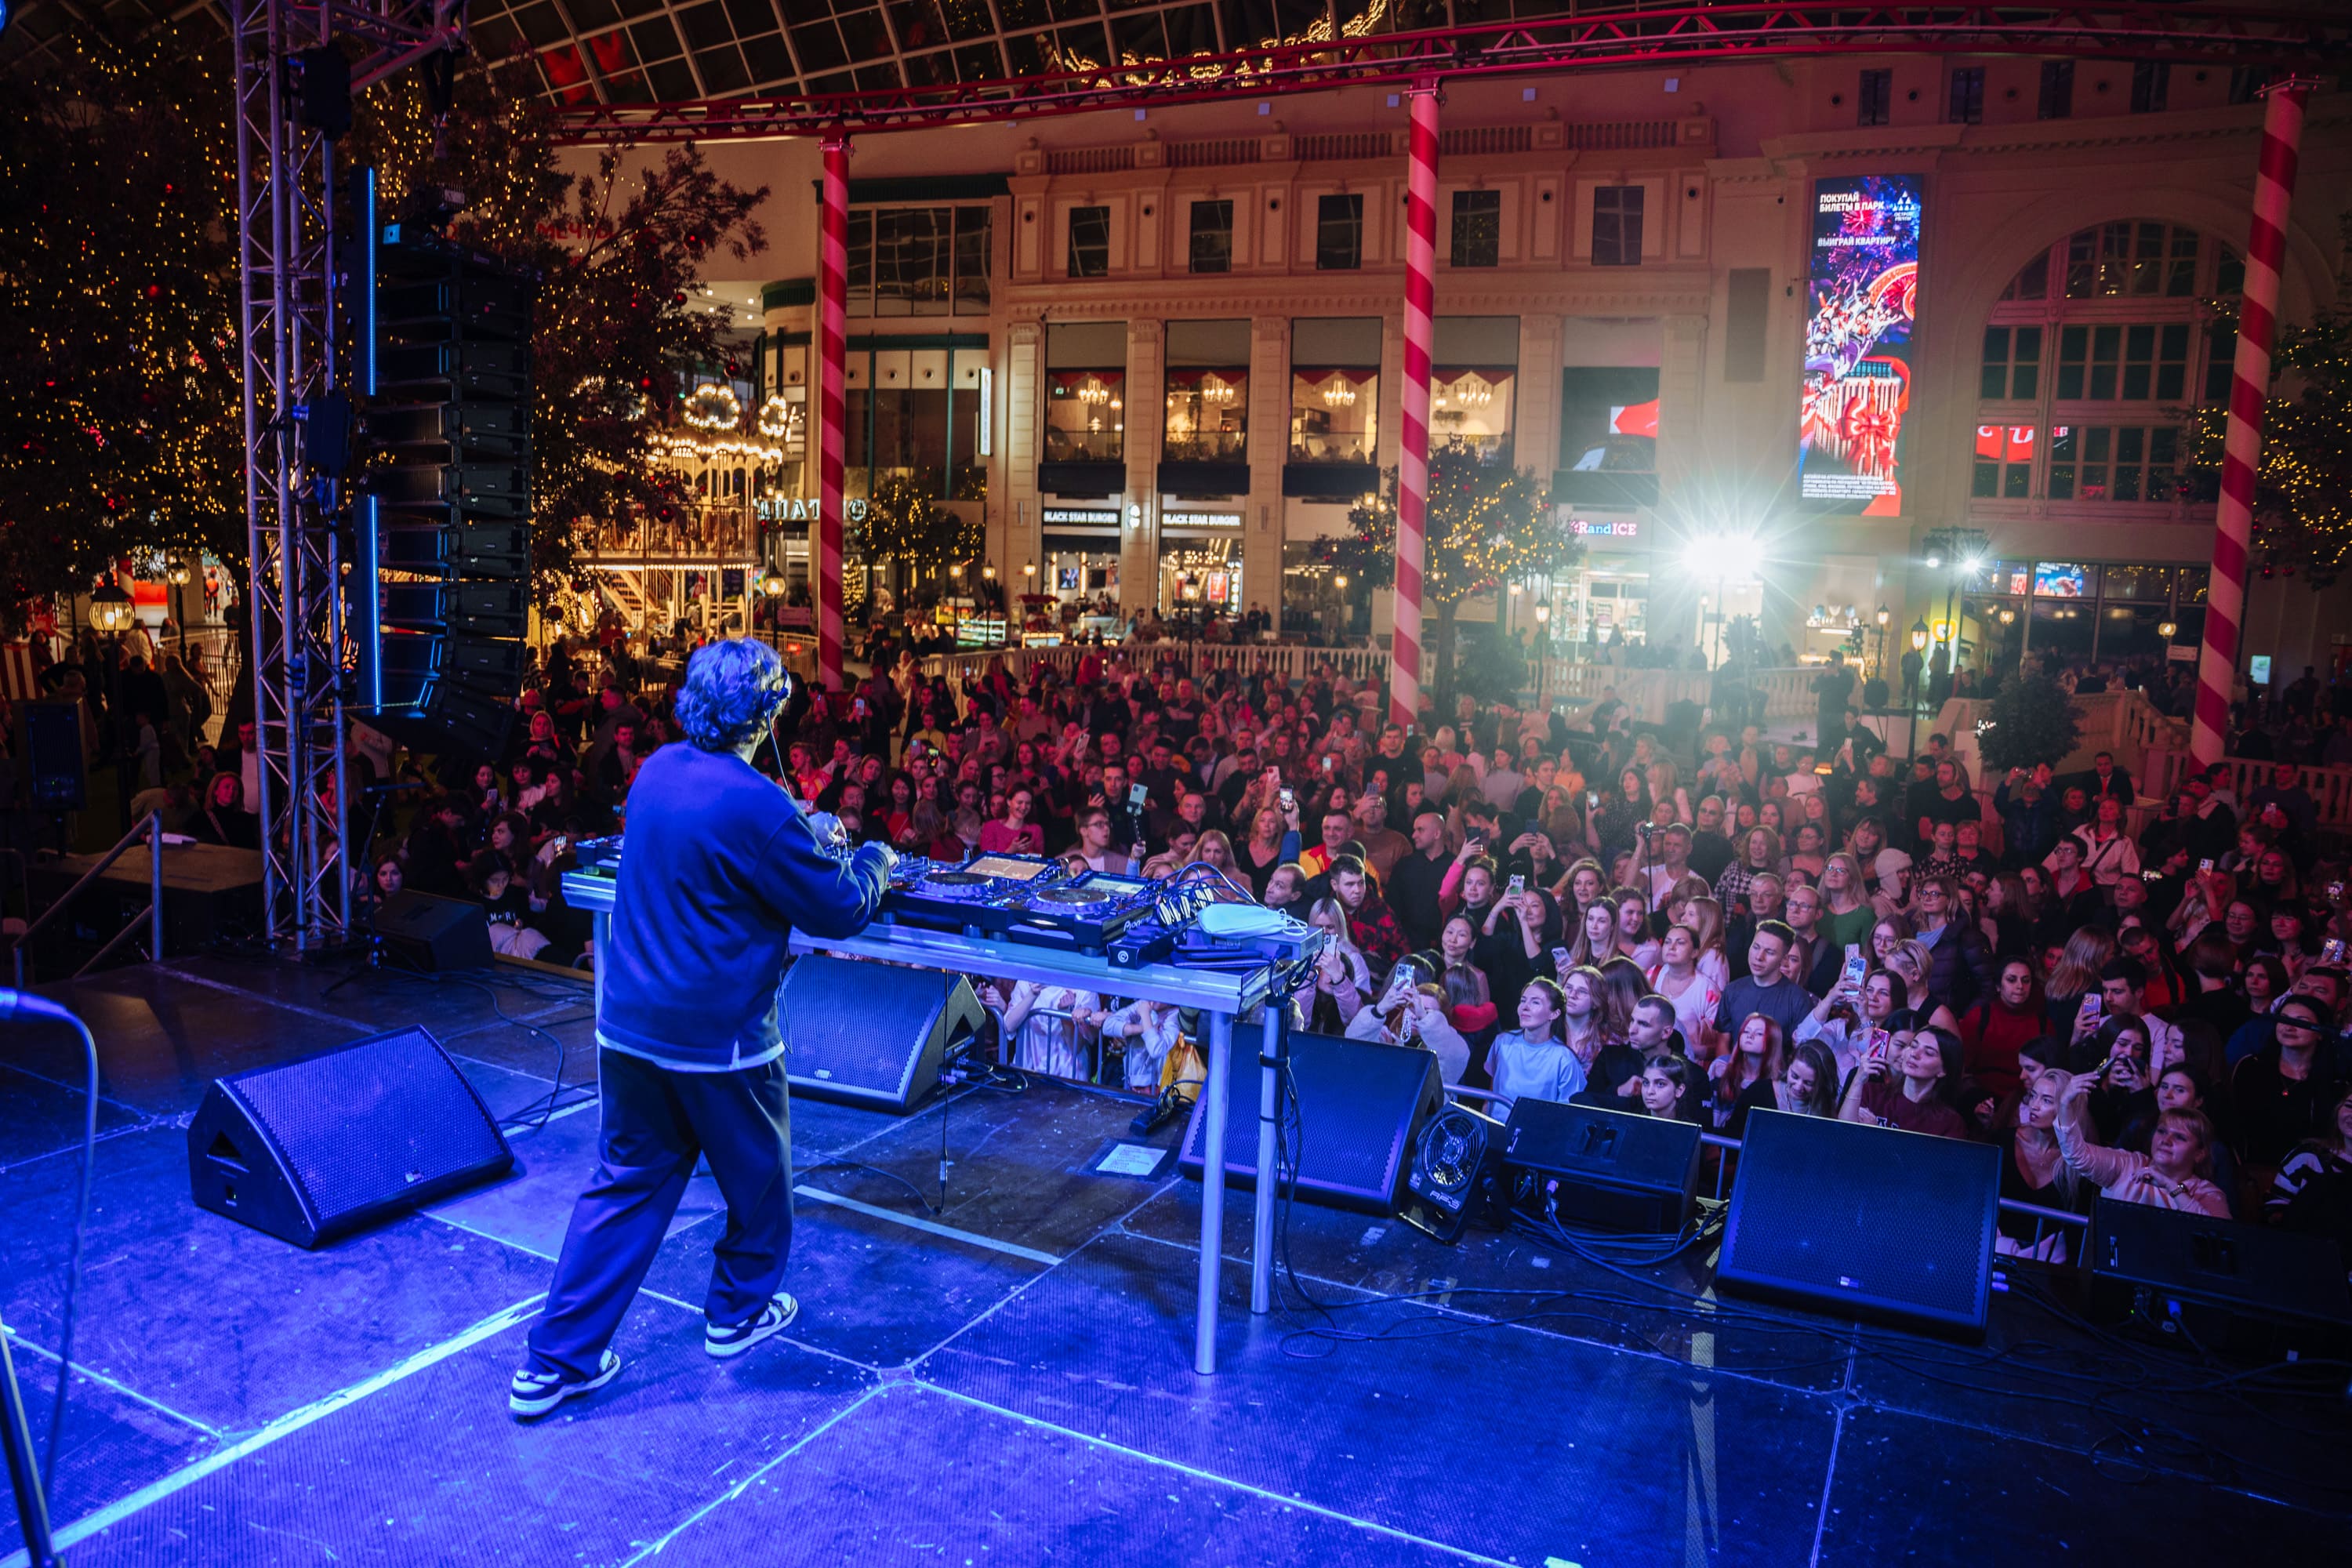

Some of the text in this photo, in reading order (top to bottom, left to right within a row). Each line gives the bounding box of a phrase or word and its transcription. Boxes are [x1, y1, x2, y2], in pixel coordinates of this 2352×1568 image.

[1820, 191, 1860, 203] ПОКУПАЙ
[1819, 201, 1885, 212] БИЛЕТЫ В ПАРК
[1817, 235, 1896, 247] ВЫИГРАЙ КВАРТИРУ
[1044, 511, 1118, 524] BLACK STAR BURGER
[1162, 514, 1240, 526] BLACK STAR BURGER
